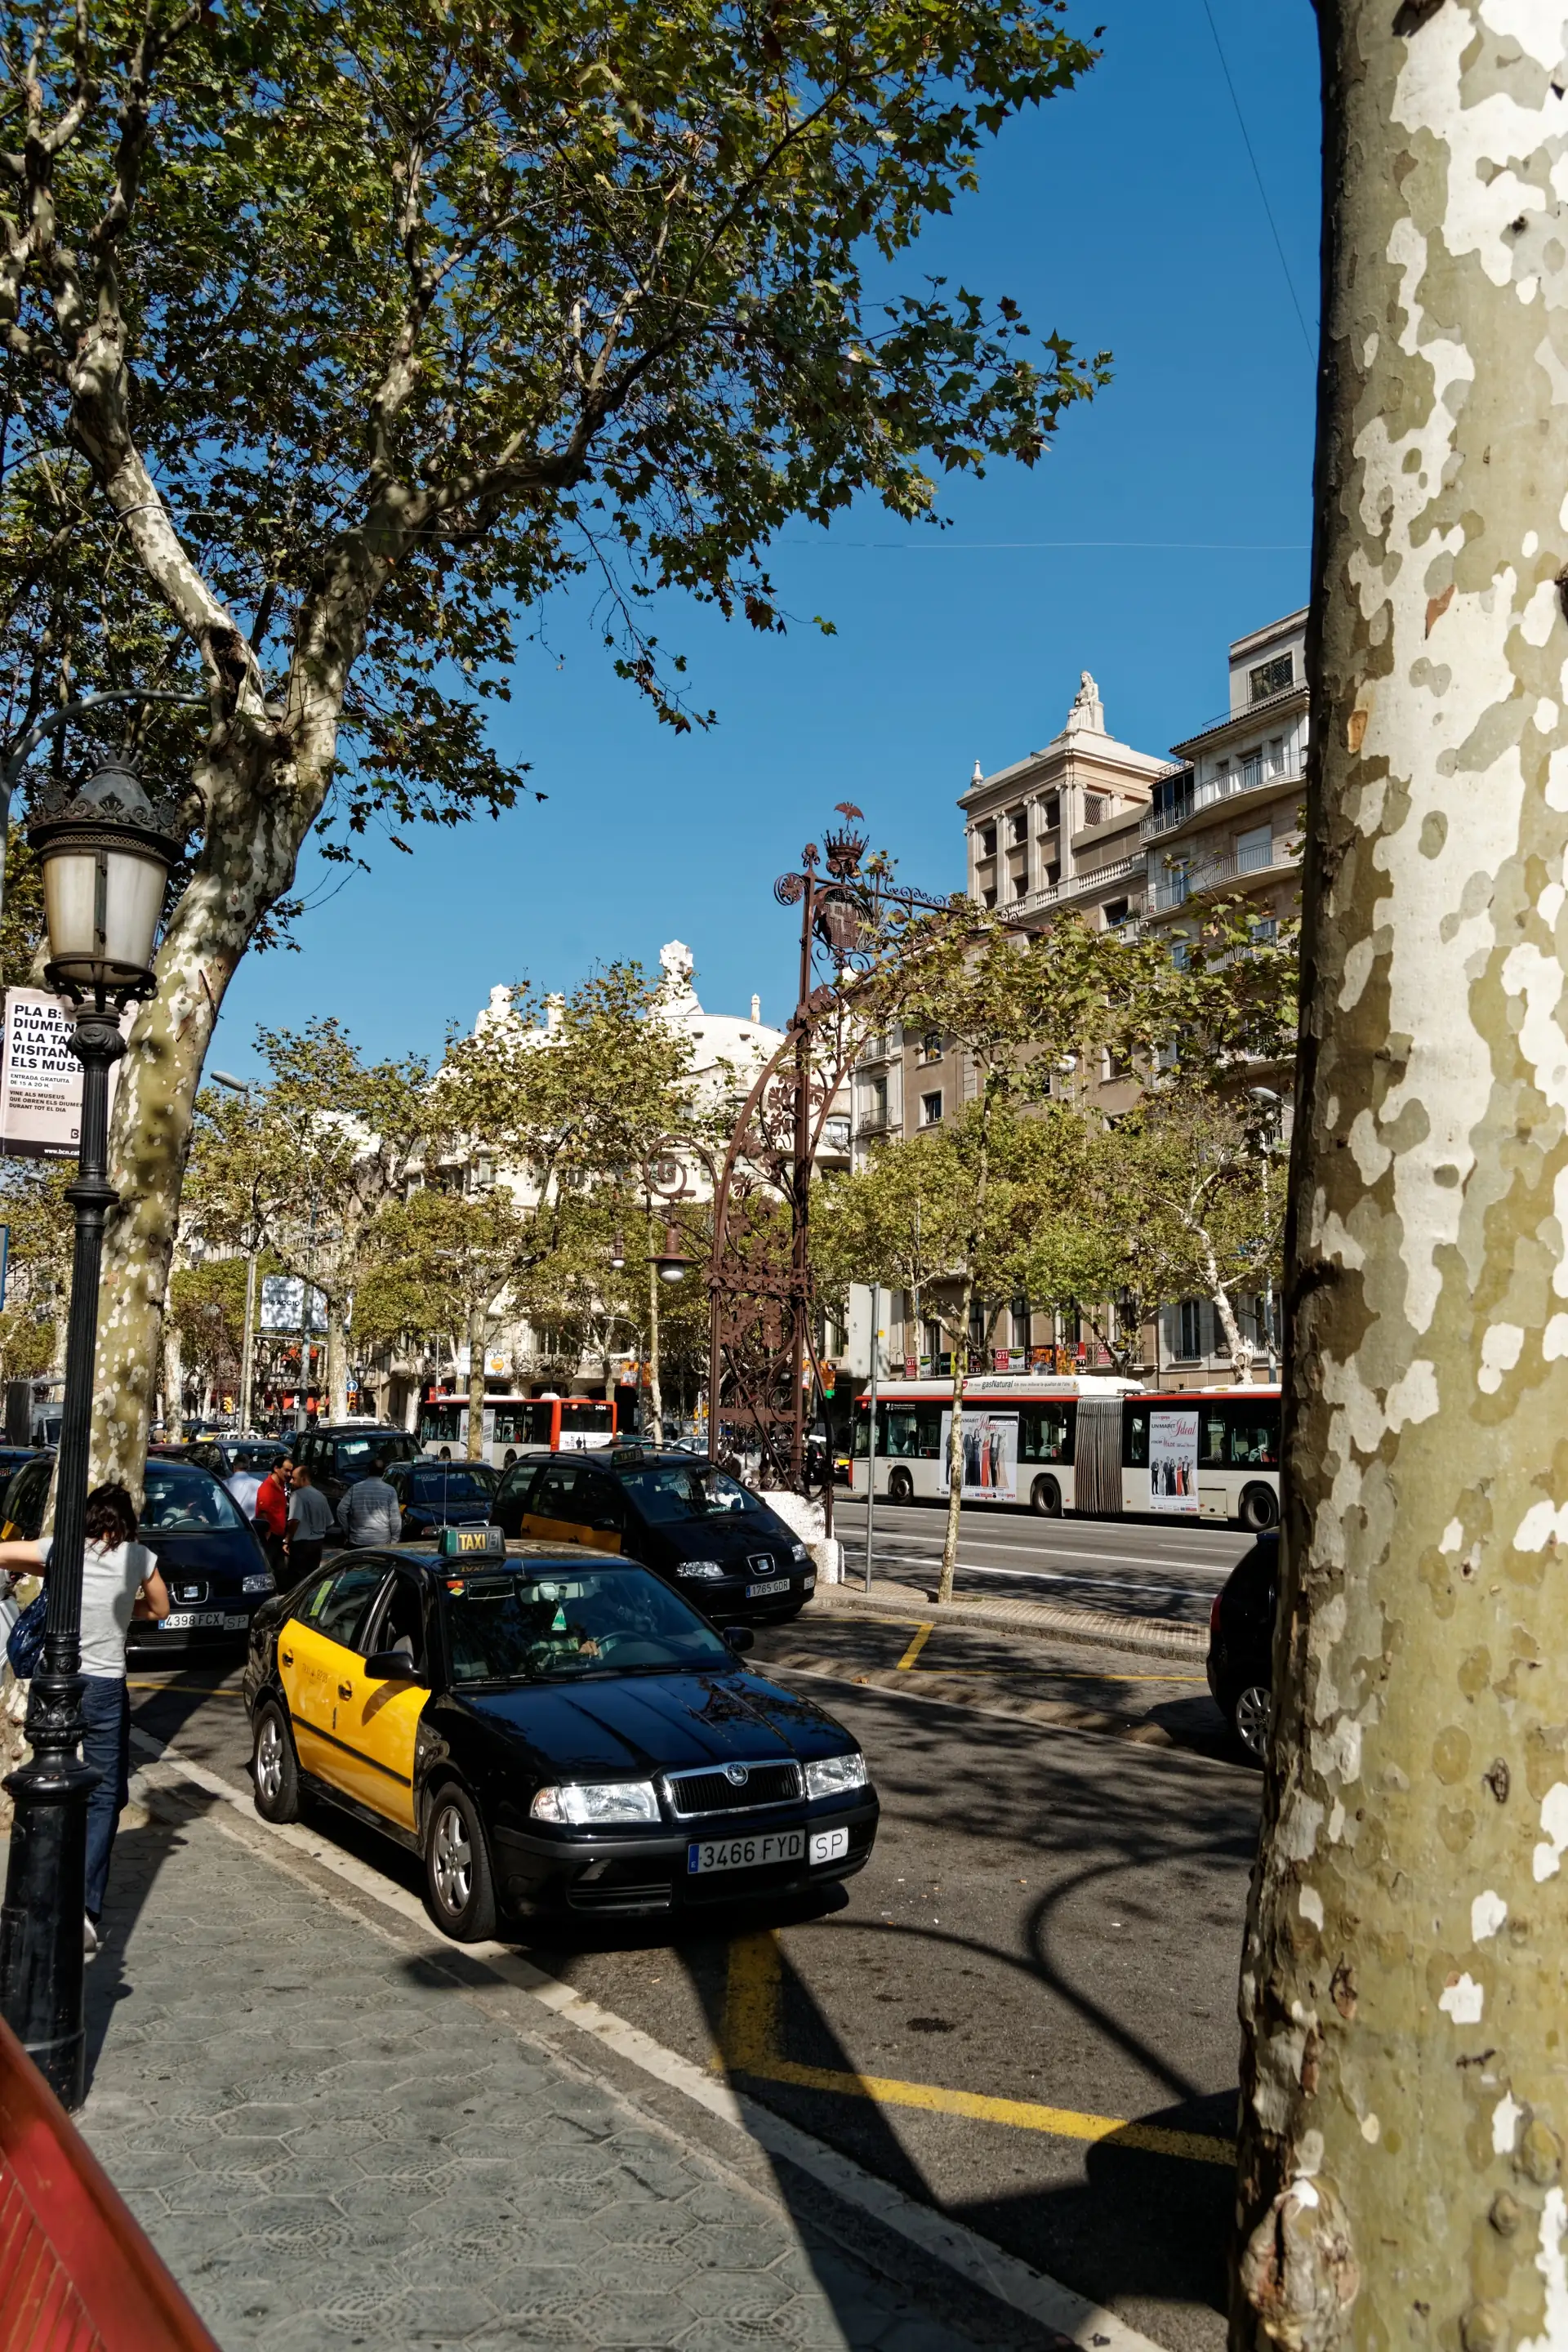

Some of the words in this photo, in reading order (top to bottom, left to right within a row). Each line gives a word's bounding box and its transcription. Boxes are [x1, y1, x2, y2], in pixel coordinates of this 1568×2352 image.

[14, 1004, 42, 1018] PLA
[47, 1008, 61, 1019] B:
[13, 1018, 75, 1033] DIUMEN
[12, 1031, 23, 1041] A
[27, 1032, 46, 1044] LA
[50, 1035, 67, 1045] TA
[11, 1056, 38, 1069] ELS
[42, 1059, 84, 1073] MUSE
[996, 1351, 1009, 1360] GTI
[982, 1380, 1013, 1389] gasNatural
[1171, 1418, 1196, 1436] Ideal
[459, 1534, 486, 1551] TAXI
[752, 1584, 772, 1595] 1765
[773, 1580, 788, 1592] GDR
[166, 1615, 196, 1627] 4398
[198, 1613, 220, 1625] FCX
[227, 1617, 246, 1628] SP
[703, 1841, 755, 1869] 3466
[762, 1834, 800, 1860] FYD
[816, 1833, 844, 1860] SP
